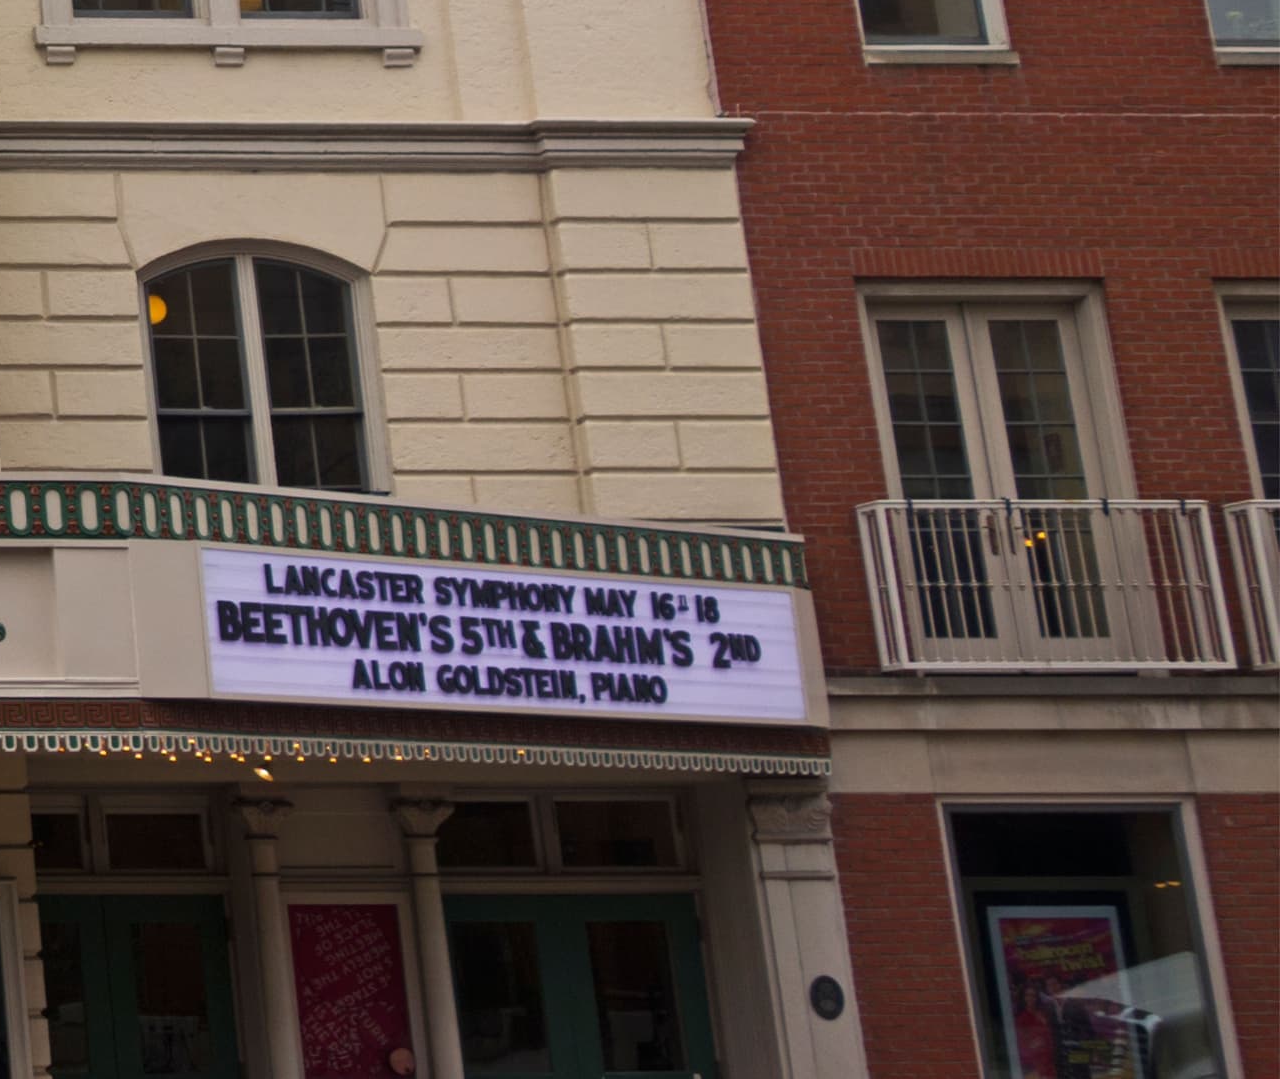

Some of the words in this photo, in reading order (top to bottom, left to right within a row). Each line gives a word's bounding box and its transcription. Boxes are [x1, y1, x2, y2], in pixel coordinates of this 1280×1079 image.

[263, 563, 425, 604] LANCASTER
[433, 577, 575, 614] SYMPHONY
[583, 587, 638, 618] MAY
[217, 600, 454, 655] BEETHOVEN'S
[459, 616, 517, 655] 5TH
[521, 619, 547, 659] &
[550, 622, 694, 667] BRAHM'S
[709, 632, 762, 669] 2ND
[352, 659, 426, 692] ALON
[436, 664, 586, 704] GOLDSTEIN,
[591, 672, 668, 704] PIANO
